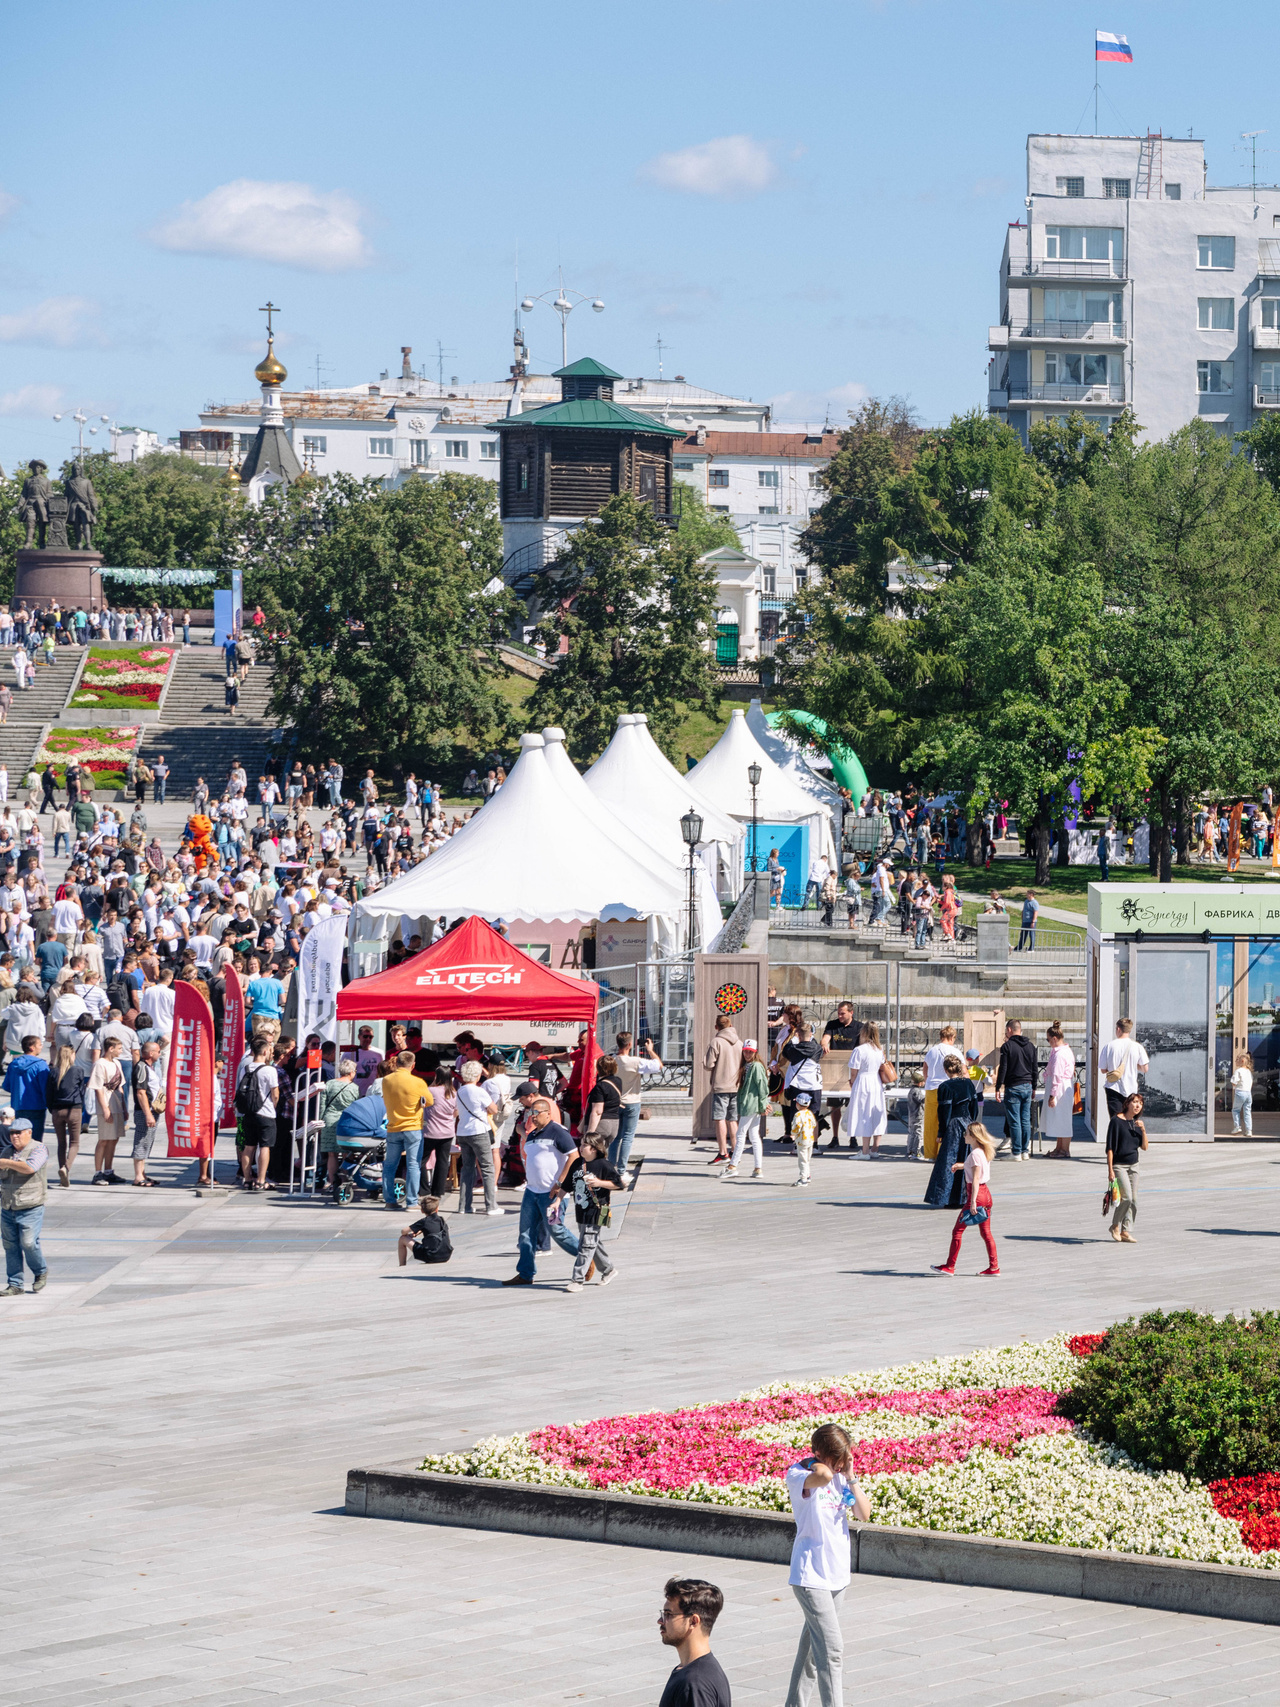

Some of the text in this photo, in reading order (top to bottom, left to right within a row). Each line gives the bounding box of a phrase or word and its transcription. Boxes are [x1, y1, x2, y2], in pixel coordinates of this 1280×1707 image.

[1141, 906, 1189, 929] Synergy
[1204, 909, 1254, 919] ФАБРИКА
[416, 972, 521, 986] ELITECH
[530, 1020, 575, 1028] ЕКАТЕРИНБУРГ
